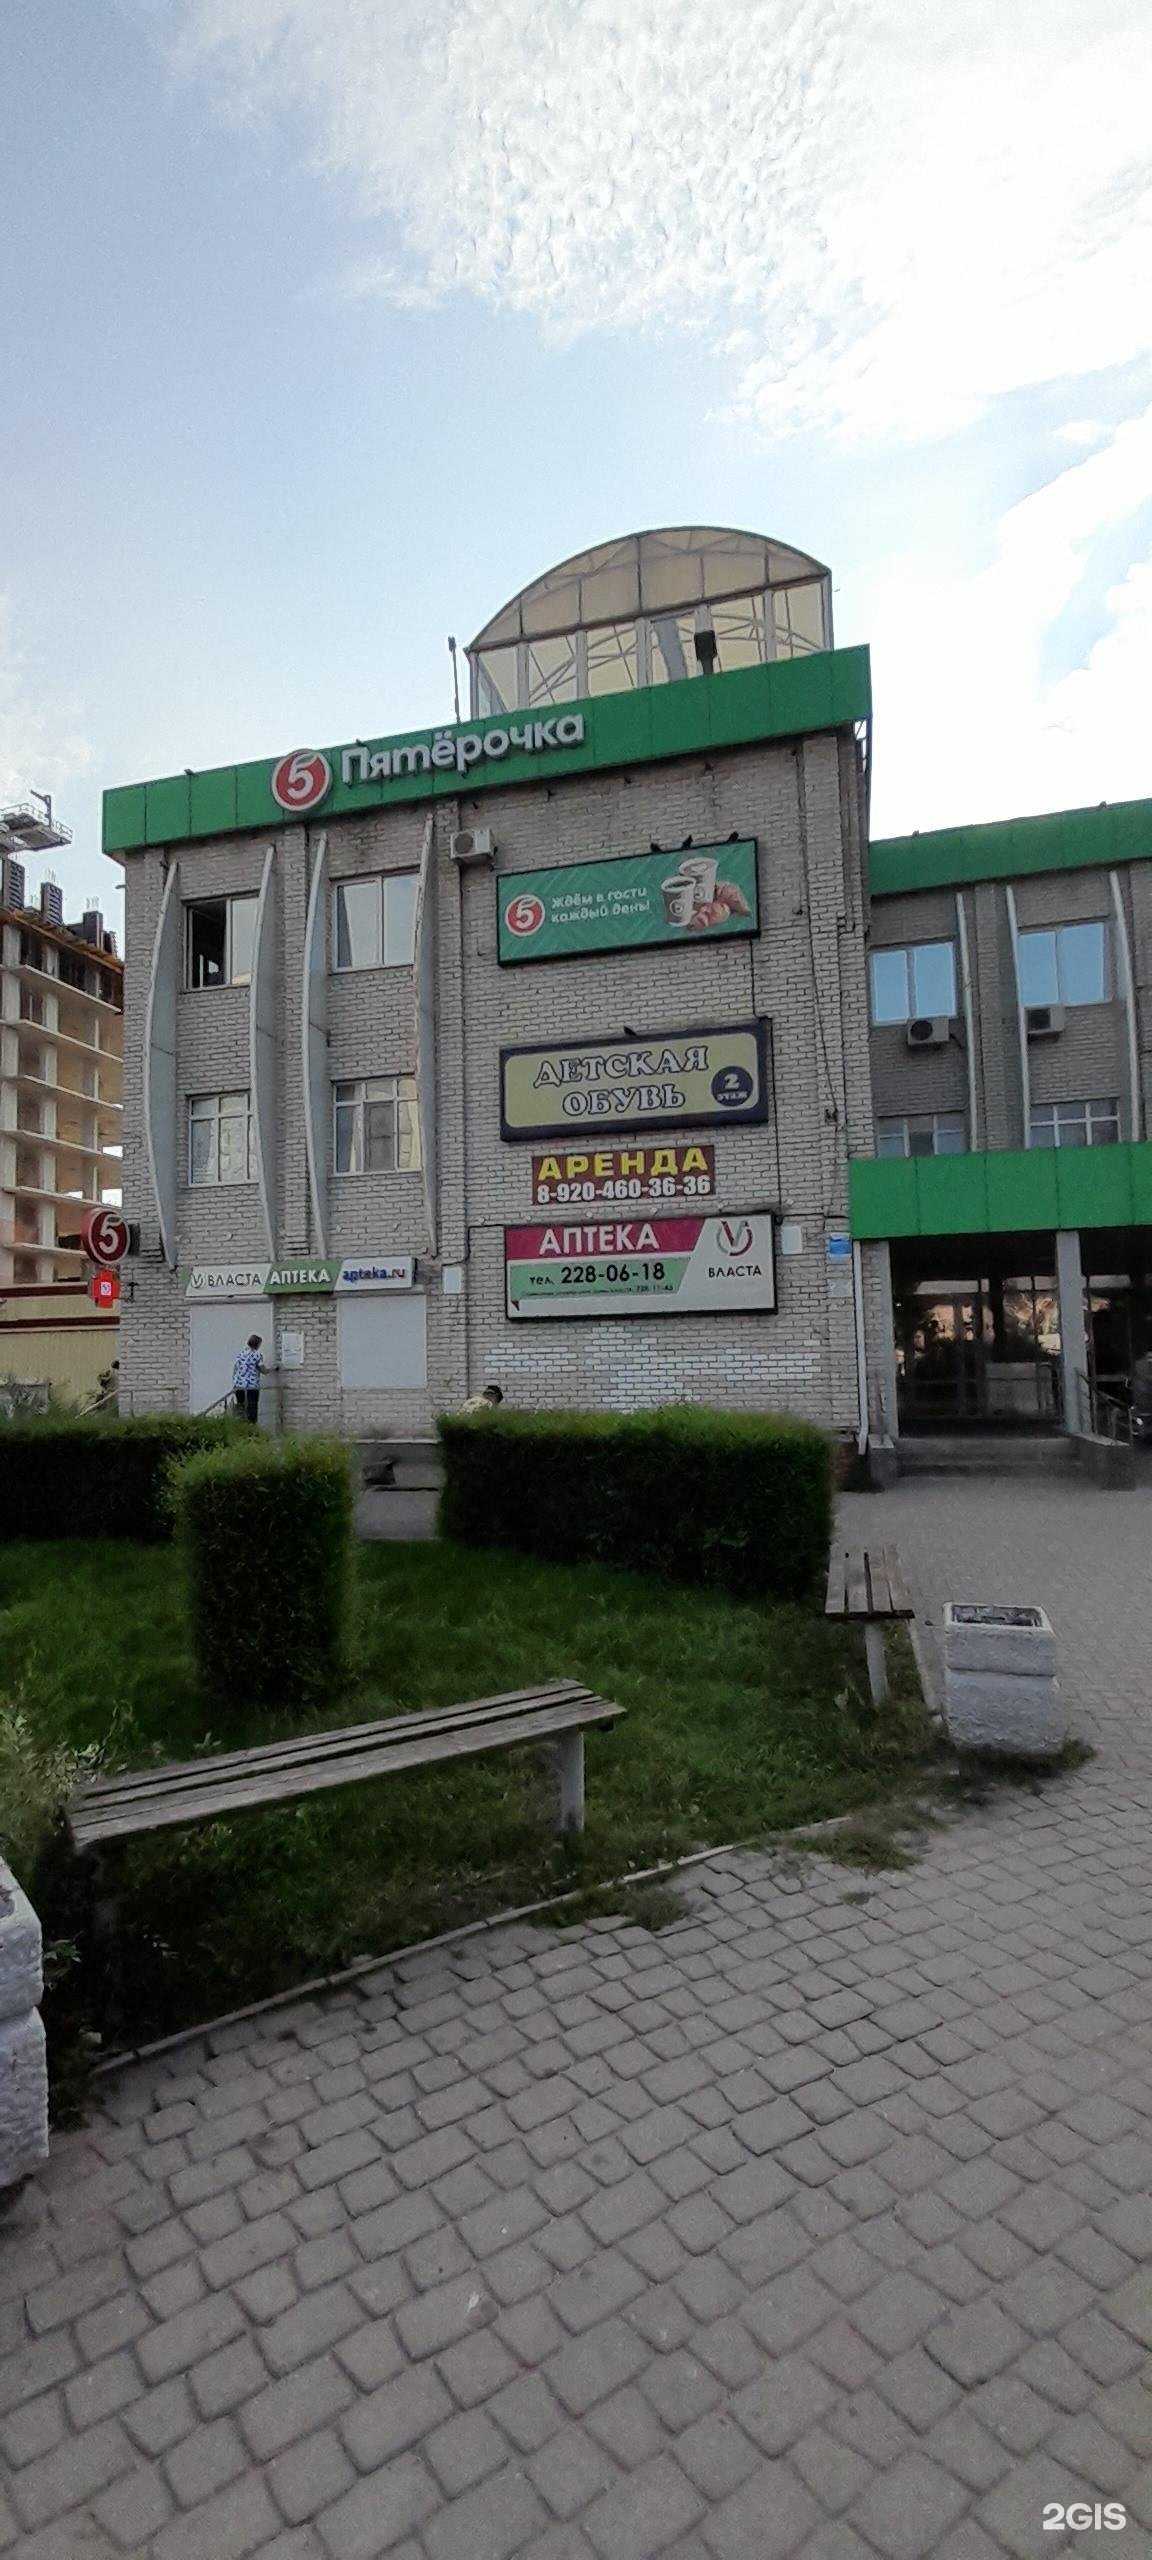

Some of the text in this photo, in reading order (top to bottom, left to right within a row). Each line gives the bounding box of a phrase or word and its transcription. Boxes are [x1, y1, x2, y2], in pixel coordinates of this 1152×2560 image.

[287, 714, 585, 800] 5 Пятёрочка
[515, 897, 537, 930] 5
[533, 1045, 709, 1089] ДЕТСКАЯ
[724, 1073, 740, 1090] 2
[562, 1083, 686, 1117] ОБУВЬ
[537, 1147, 709, 1181] АРЕНДА
[537, 1174, 711, 1205] 8-920-460-36-36
[98, 1213, 123, 1255] 5
[538, 1223, 661, 1256] АПТЕКА
[207, 1267, 331, 1288] ВЛАСТА АПТЕКА
[341, 1266, 406, 1283] apteka.ru
[560, 1261, 666, 1285] 228-06-18
[707, 1264, 763, 1279] ВЛАСТА
